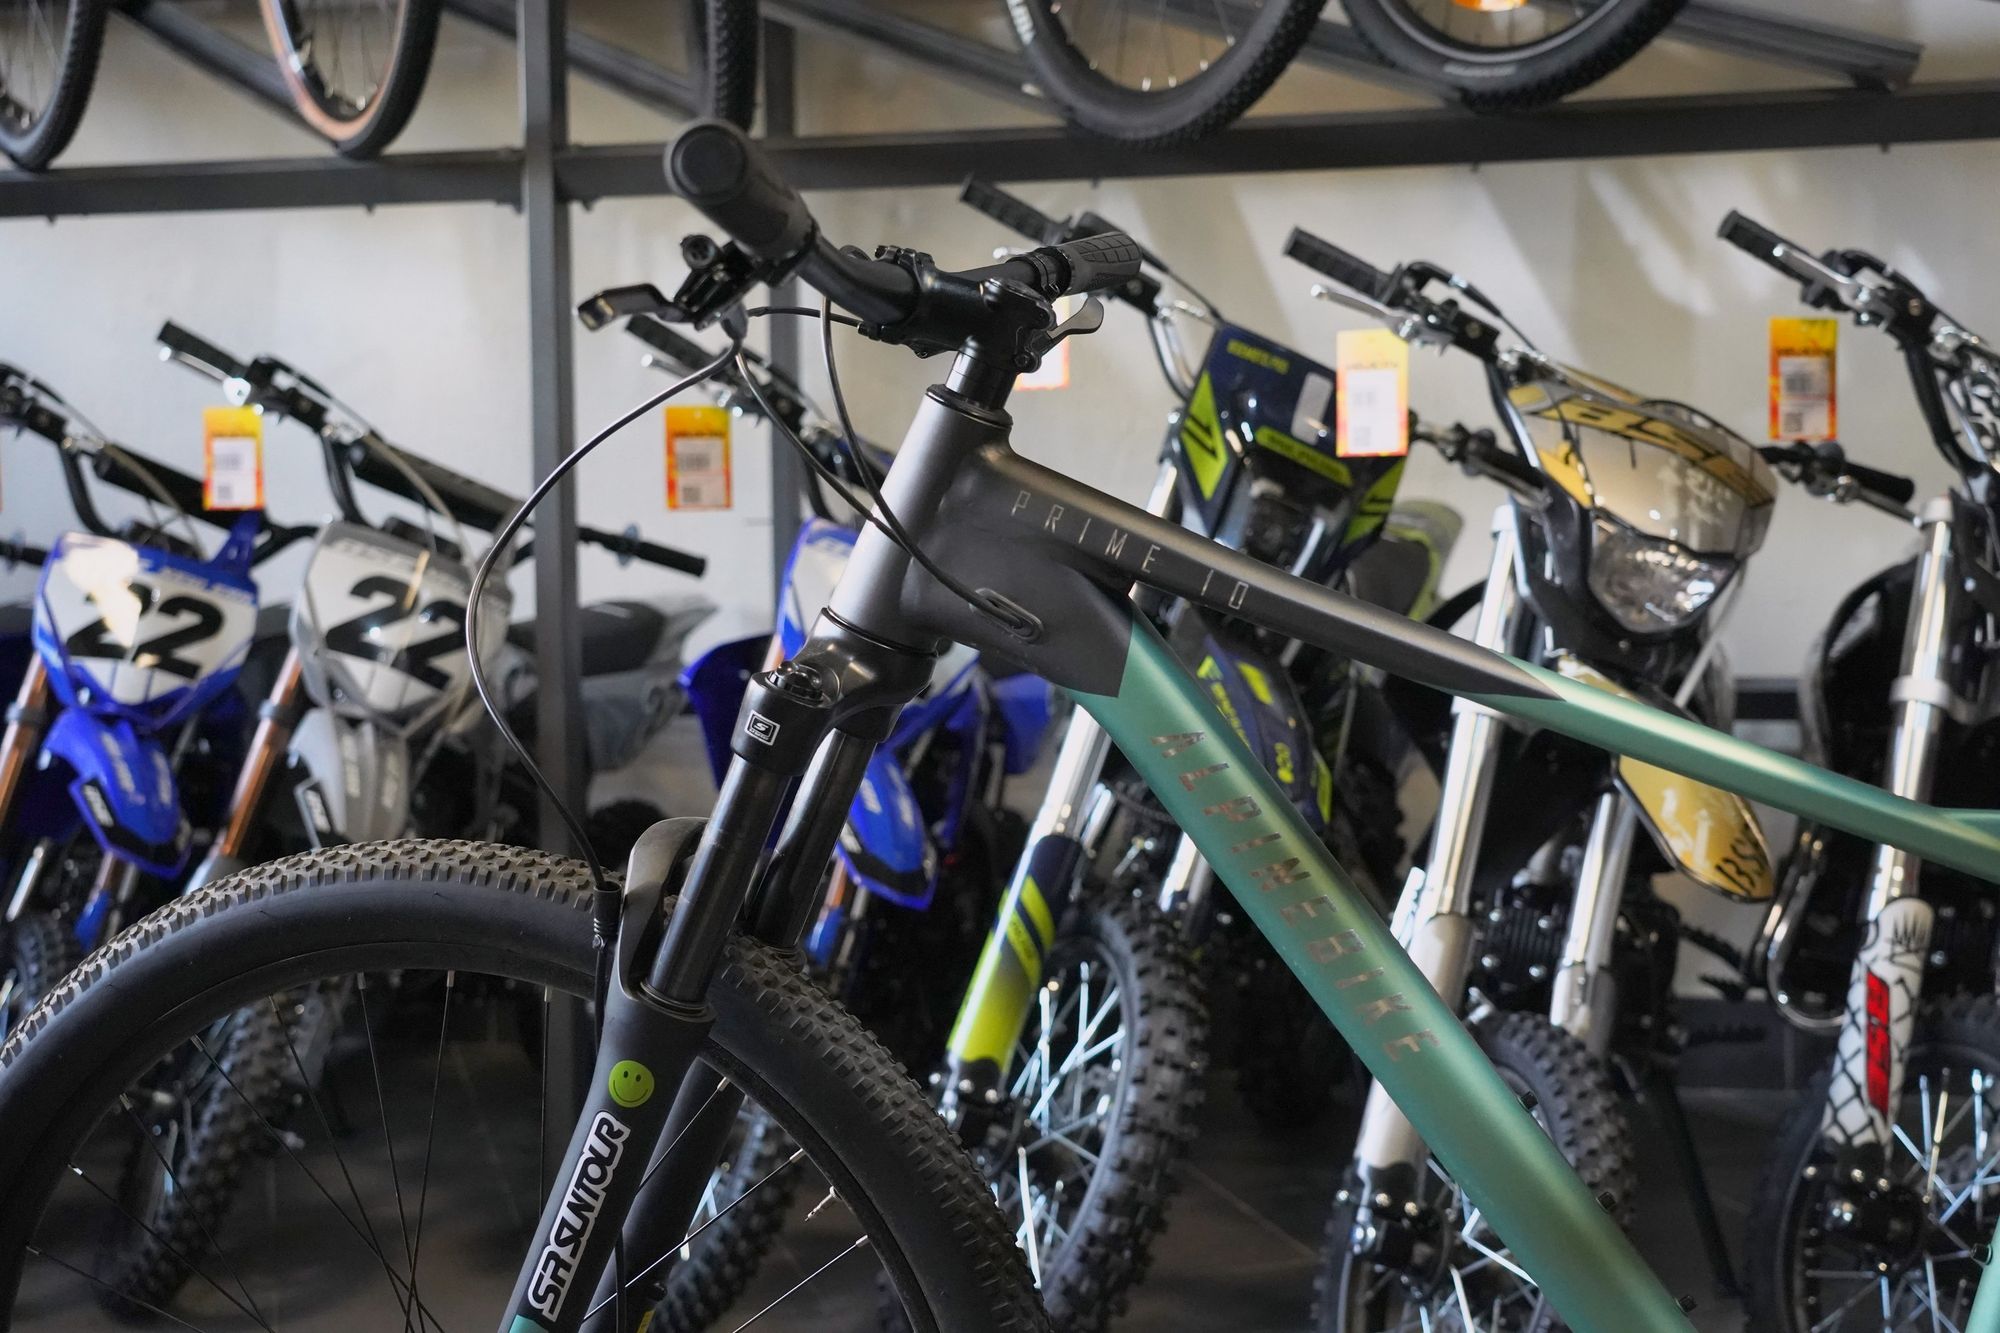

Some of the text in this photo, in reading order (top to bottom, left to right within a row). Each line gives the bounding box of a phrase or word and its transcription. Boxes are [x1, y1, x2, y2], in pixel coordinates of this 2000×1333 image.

[1011, 490, 1249, 610] PRIME 10
[326, 576, 472, 690] 22
[532, 1116, 625, 1316] SR SUNTOUR
